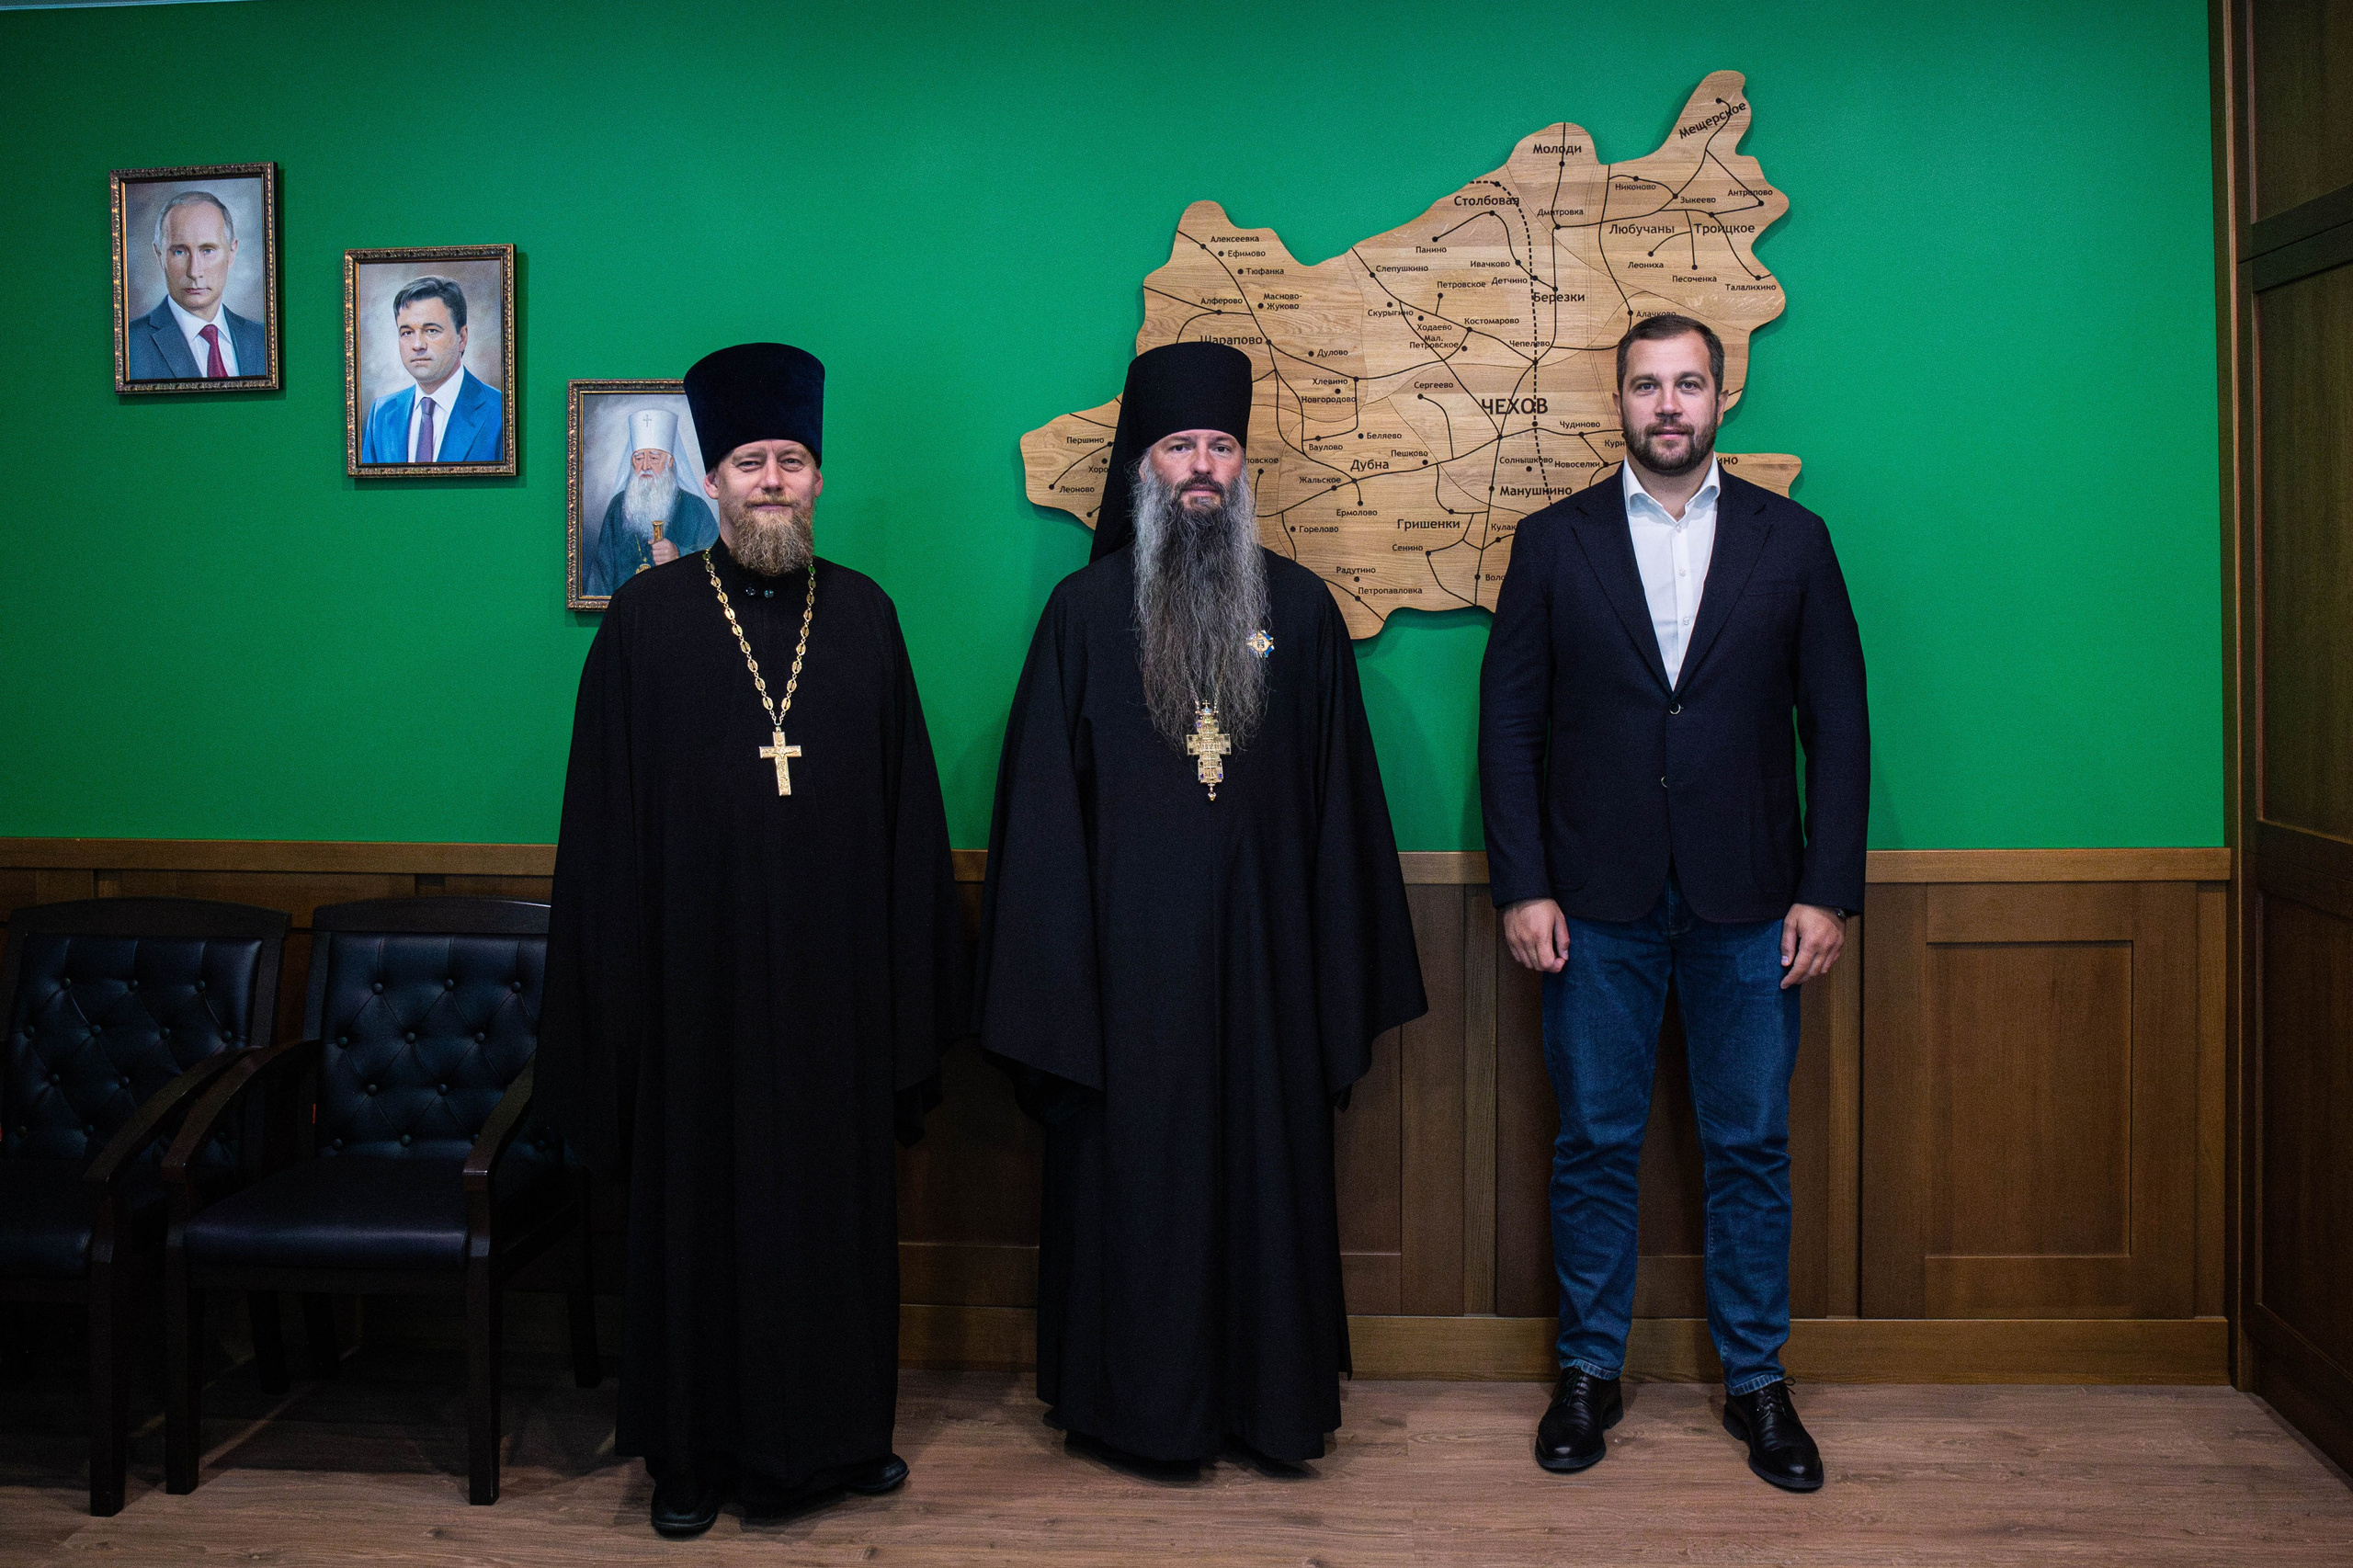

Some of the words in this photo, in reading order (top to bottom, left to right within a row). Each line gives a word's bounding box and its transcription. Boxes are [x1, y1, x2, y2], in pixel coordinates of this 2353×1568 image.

[1678, 100, 1747, 140] Мещерское
[1533, 143, 1582, 156] Молоди
[1615, 183, 1656, 191] Никоново
[1454, 195, 1519, 208] Столбовая
[1680, 196, 1716, 204] Зыкеево
[1537, 208, 1584, 217] Дмитровка
[1608, 223, 1676, 236] Любучаны
[1693, 223, 1756, 236] Троицкое
[1211, 235, 1259, 244] Алексеевка
[1227, 250, 1266, 258] Ефимово
[1415, 246, 1447, 255] Панино
[1470, 260, 1510, 268] Ивачково
[1628, 261, 1665, 269] Леониха
[1245, 267, 1285, 277] Тюфанка
[1376, 265, 1428, 274] Слепушкино
[1492, 277, 1528, 286] Детчино
[1672, 275, 1717, 283] Песоченка
[1437, 280, 1486, 290] Петровское
[1725, 283, 1777, 291] Талалихино
[1200, 297, 1243, 305] Алферово
[1533, 291, 1586, 303] Березки
[1267, 302, 1299, 311] Жуково
[1368, 309, 1414, 318] Скурыгино
[1464, 317, 1519, 325] Костомарово
[1416, 324, 1452, 332] Ходаево
[1200, 335, 1263, 346] Шарапово
[1409, 341, 1459, 349] Петровское
[1509, 340, 1551, 348] Чепелево
[1317, 349, 1348, 358] Дулово
[1313, 378, 1348, 386] Хлевино
[1414, 381, 1454, 390] Сергеево
[1301, 396, 1356, 404] Новгородово
[1482, 398, 1549, 415] ЧЕХОВ
[1559, 420, 1600, 429] Чудиново
[1066, 437, 1105, 445] Першино
[1309, 443, 1343, 451] Ваулово
[1391, 449, 1428, 458] Пешково
[1499, 456, 1553, 464] Солнышково
[1554, 460, 1600, 469] Новоселки
[1350, 460, 1390, 472] Дубна
[1299, 476, 1341, 484] Жальское
[1499, 485, 1573, 497] Манушкино
[1336, 508, 1378, 517] Ермолово
[1397, 518, 1461, 531] Гришенки
[1392, 543, 1423, 552] Сенино
[1336, 566, 1376, 574] Радутино
[1358, 587, 1423, 596] Петропавловка
